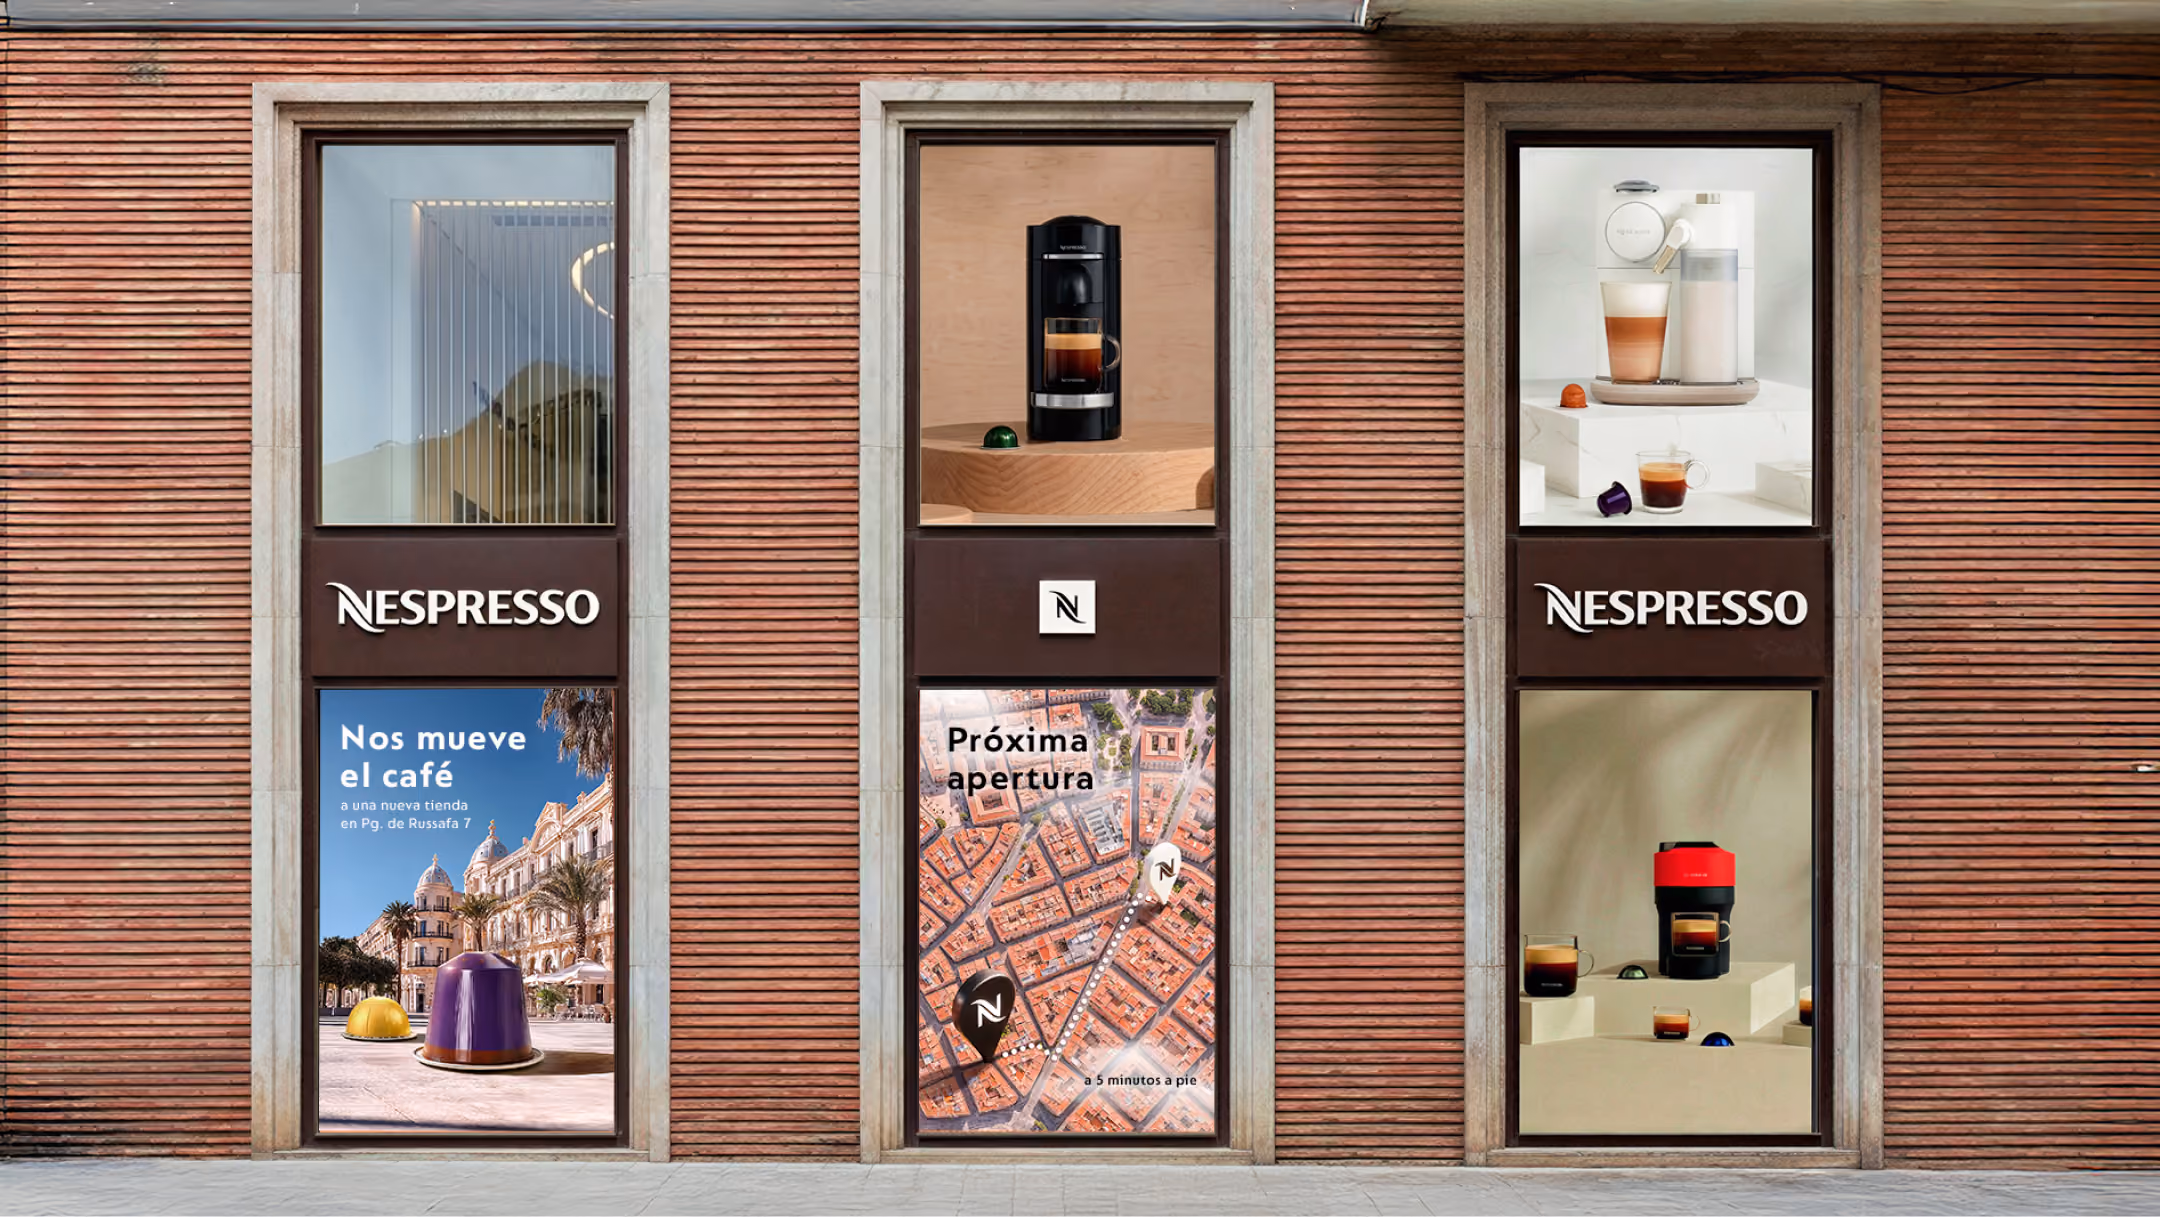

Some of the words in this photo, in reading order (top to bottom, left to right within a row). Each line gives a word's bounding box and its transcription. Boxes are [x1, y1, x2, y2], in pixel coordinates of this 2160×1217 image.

[325, 582, 600, 633] NESPRESSO
[1048, 589, 1087, 624] N
[1534, 583, 1808, 633] NESPRESSO
[341, 724, 404, 750] Nos
[418, 731, 526, 751] mueve
[949, 726, 1088, 752] Próxima
[341, 762, 370, 788] el
[383, 761, 453, 788] café
[948, 768, 1093, 796] apertura
[340, 801, 348, 811] a
[352, 801, 377, 811] una
[381, 801, 420, 811] nueva
[425, 799, 468, 811] tienda
[340, 819, 358, 829] en
[361, 817, 384, 832] Pg.
[388, 817, 405, 829] de
[409, 817, 459, 829] Russafa
[463, 817, 471, 829] 7
[1084, 1076, 1092, 1086] a
[1096, 1074, 1104, 1086] 5
[1108, 1074, 1161, 1086] minutos
[1164, 1076, 1172, 1086] a
[1176, 1073, 1197, 1088] pie
